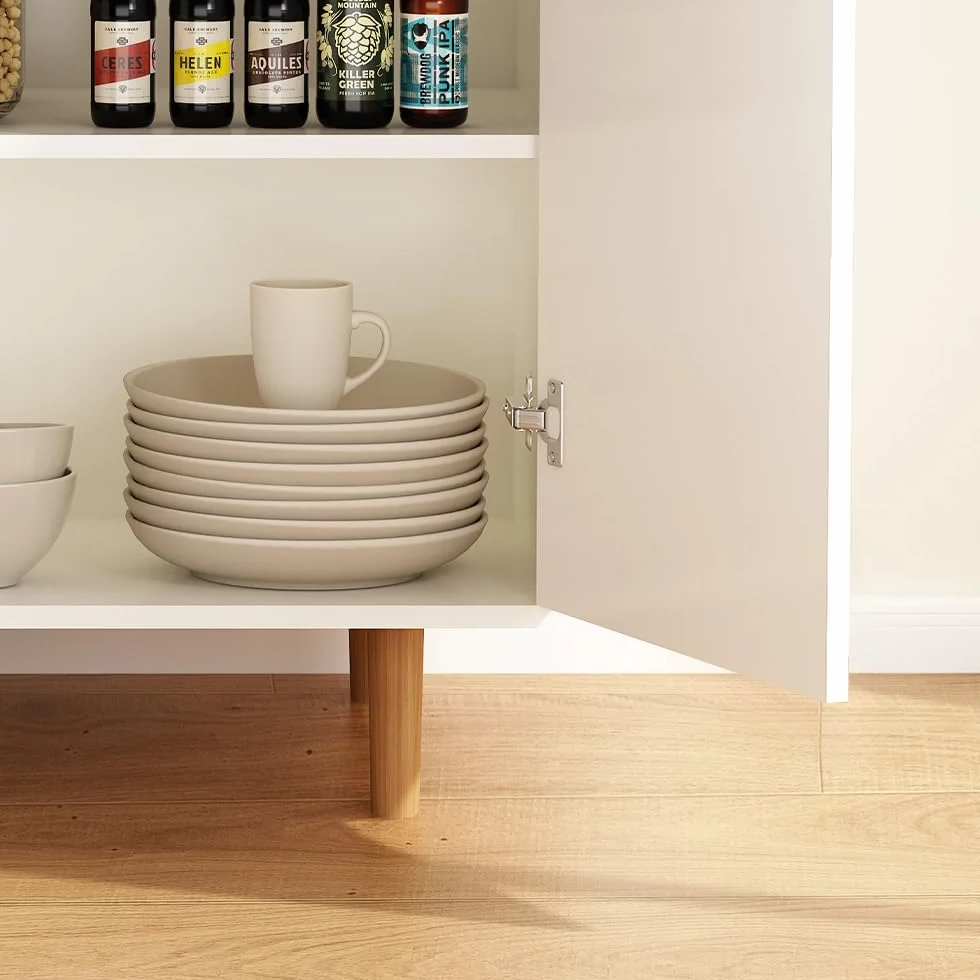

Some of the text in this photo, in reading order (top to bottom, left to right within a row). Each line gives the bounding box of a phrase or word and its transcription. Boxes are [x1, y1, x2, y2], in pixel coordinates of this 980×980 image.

[101, 56, 143, 69] CERES
[179, 56, 221, 69] HELEN
[250, 56, 302, 71] AQUILES
[438, 19, 450, 104] PUNK IPA
[338, 70, 375, 78] KILLER
[420, 53, 432, 104] BREWDOG
[338, 80, 374, 89] GREEN
